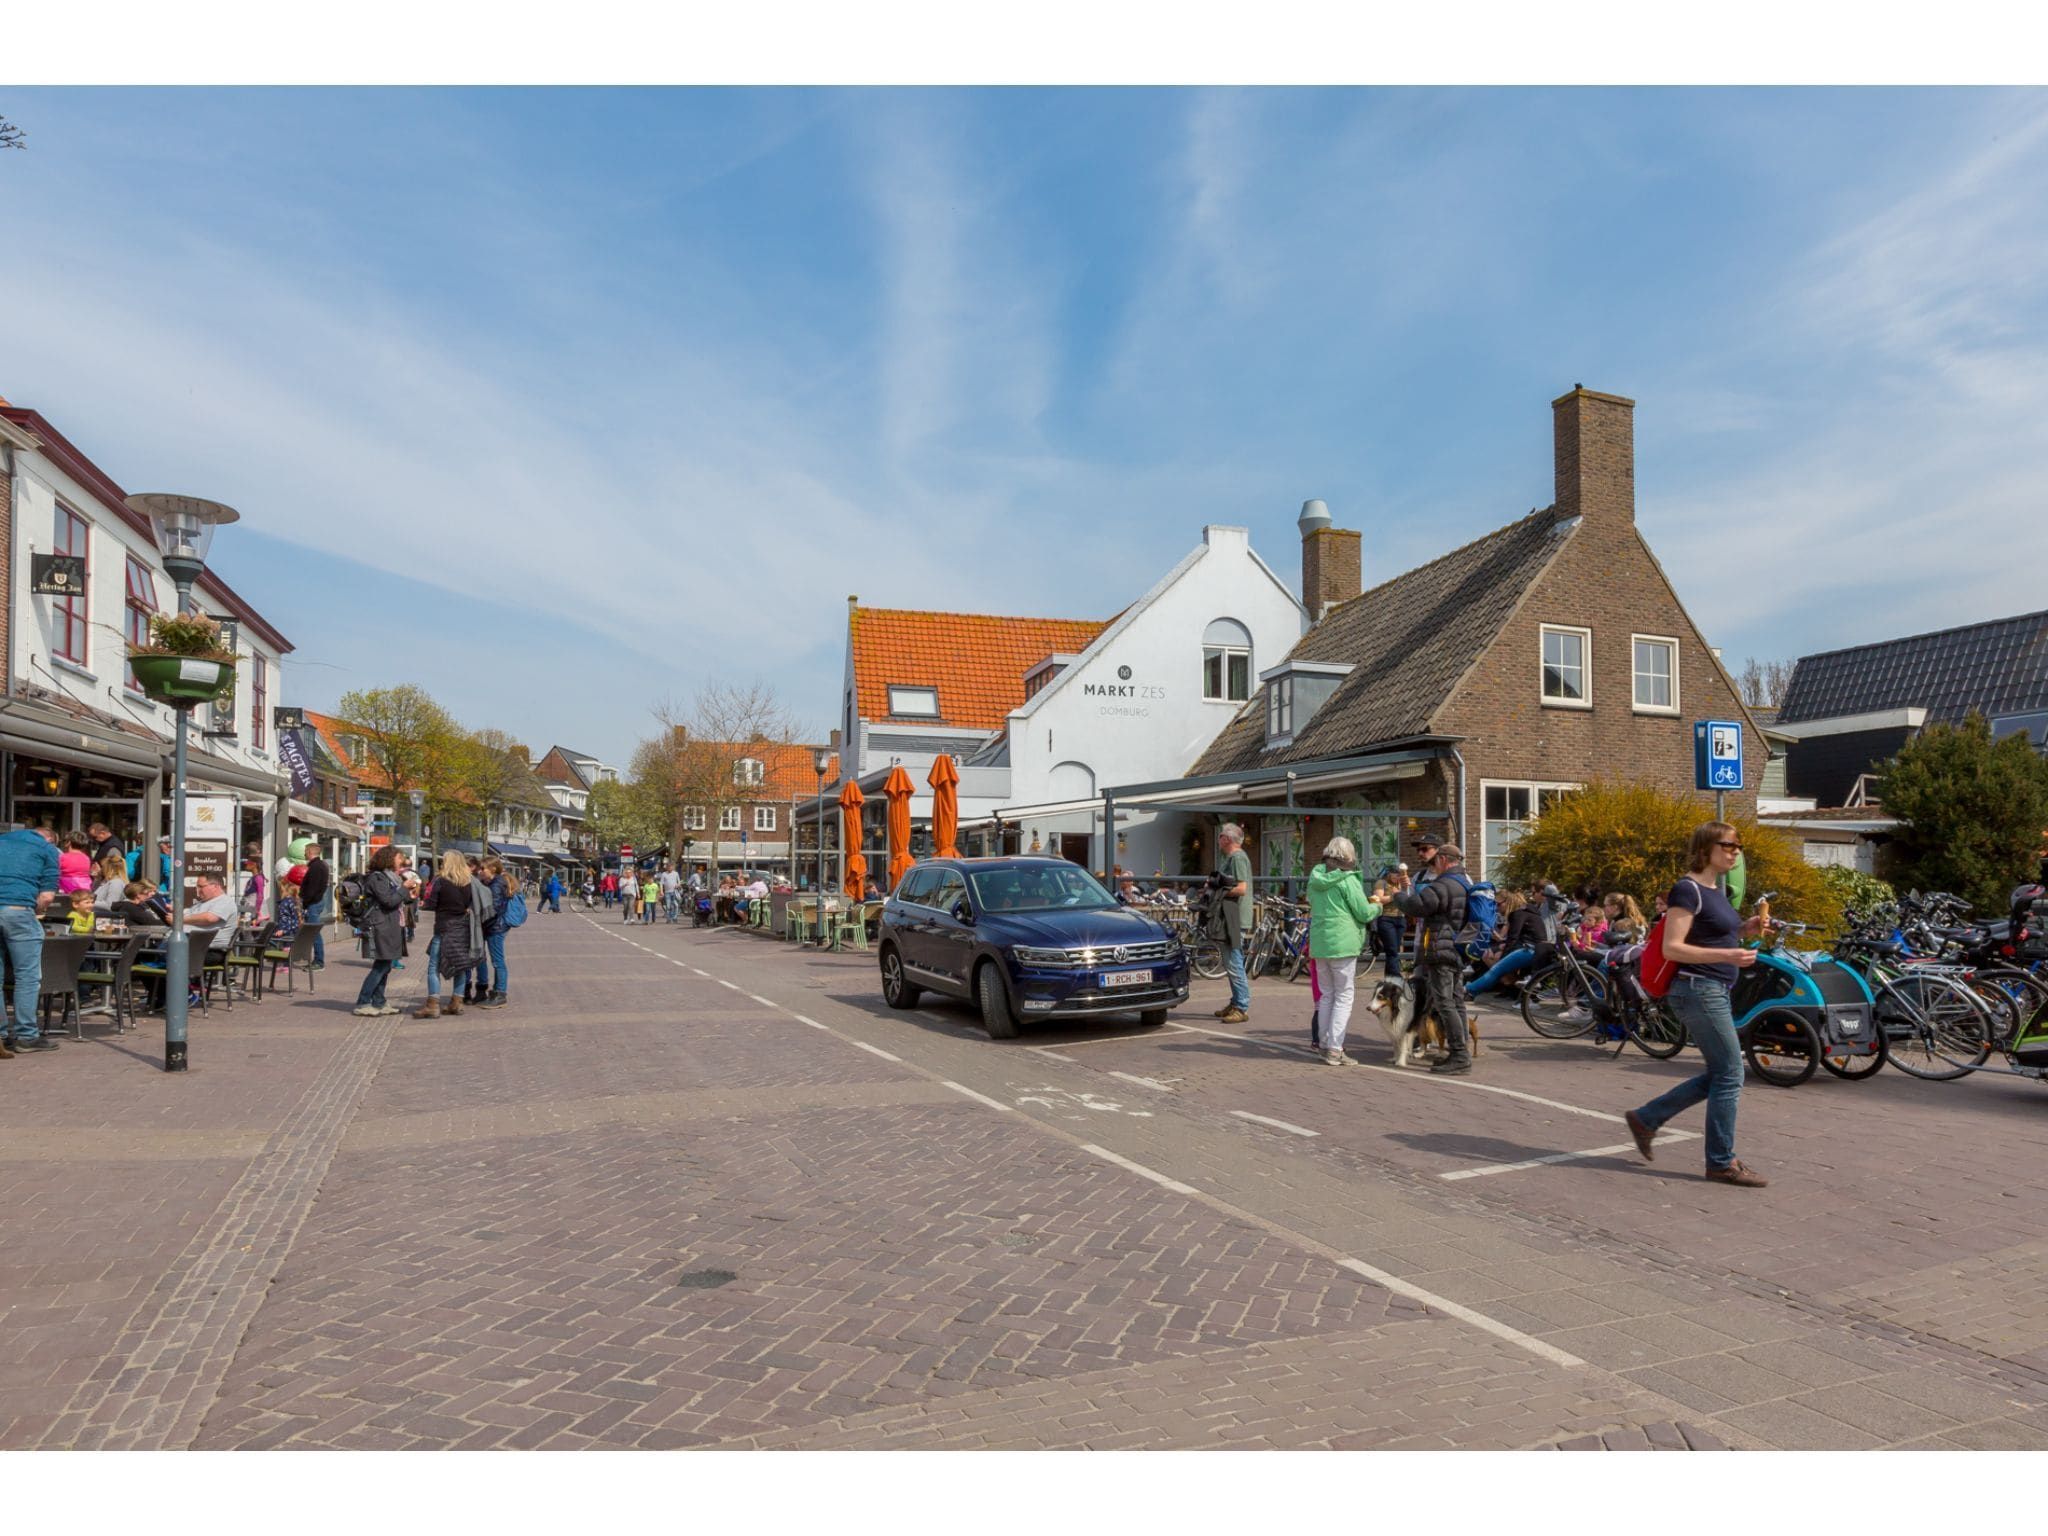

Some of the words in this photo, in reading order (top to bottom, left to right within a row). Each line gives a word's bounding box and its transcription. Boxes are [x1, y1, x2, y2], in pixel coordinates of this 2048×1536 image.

[1084, 684, 1135, 697] MARKT
[1141, 686, 1166, 699] ZES
[1100, 706, 1149, 717] DOMBURG
[283, 741, 311, 788] PAGTER
